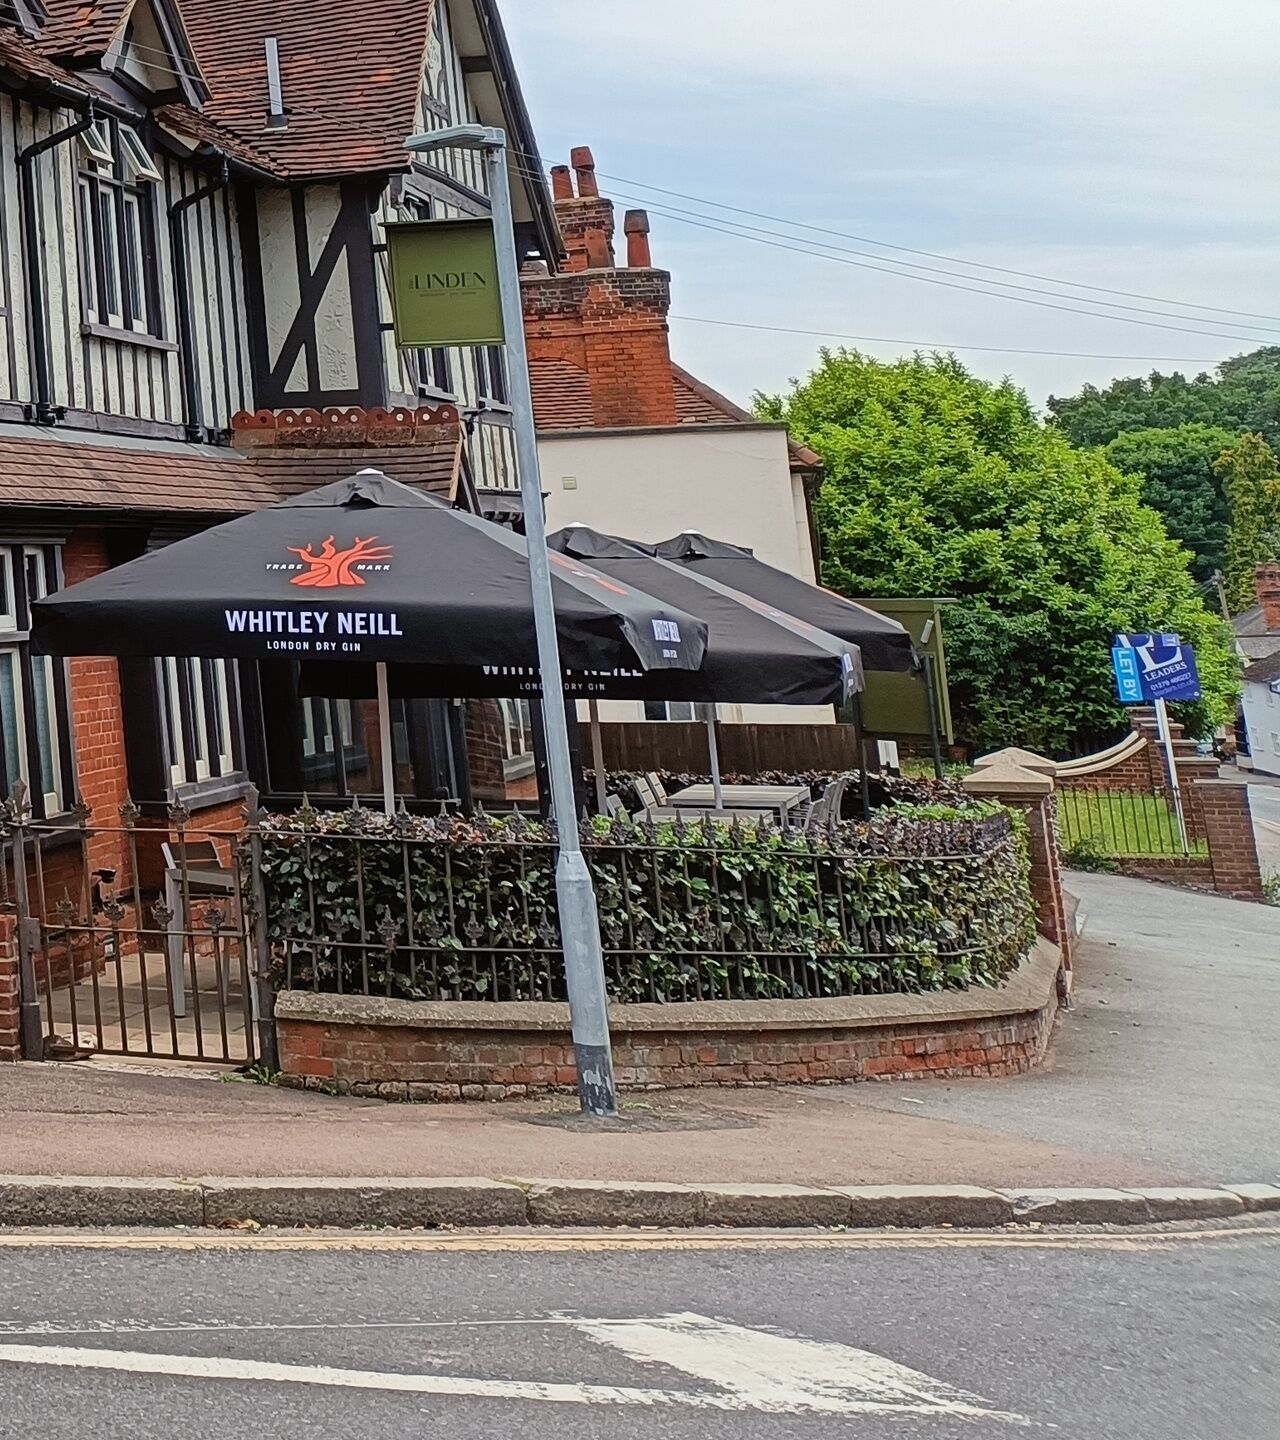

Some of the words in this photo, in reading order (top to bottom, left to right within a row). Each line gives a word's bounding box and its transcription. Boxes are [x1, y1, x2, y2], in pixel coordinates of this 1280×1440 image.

[414, 271, 487, 290] LINDEN
[356, 563, 391, 571] MARK
[224, 610, 329, 634] WHITLEY
[337, 612, 403, 636] NEILL
[266, 640, 310, 651] LONDON
[315, 642, 337, 651] DRY
[342, 643, 361, 652] GIN
[1117, 650, 1134, 675] LET
[1144, 661, 1187, 682] LEADERS
[564, 682, 583, 691] DRY
[588, 683, 606, 691] GIN
[1122, 680, 1138, 699] BY
